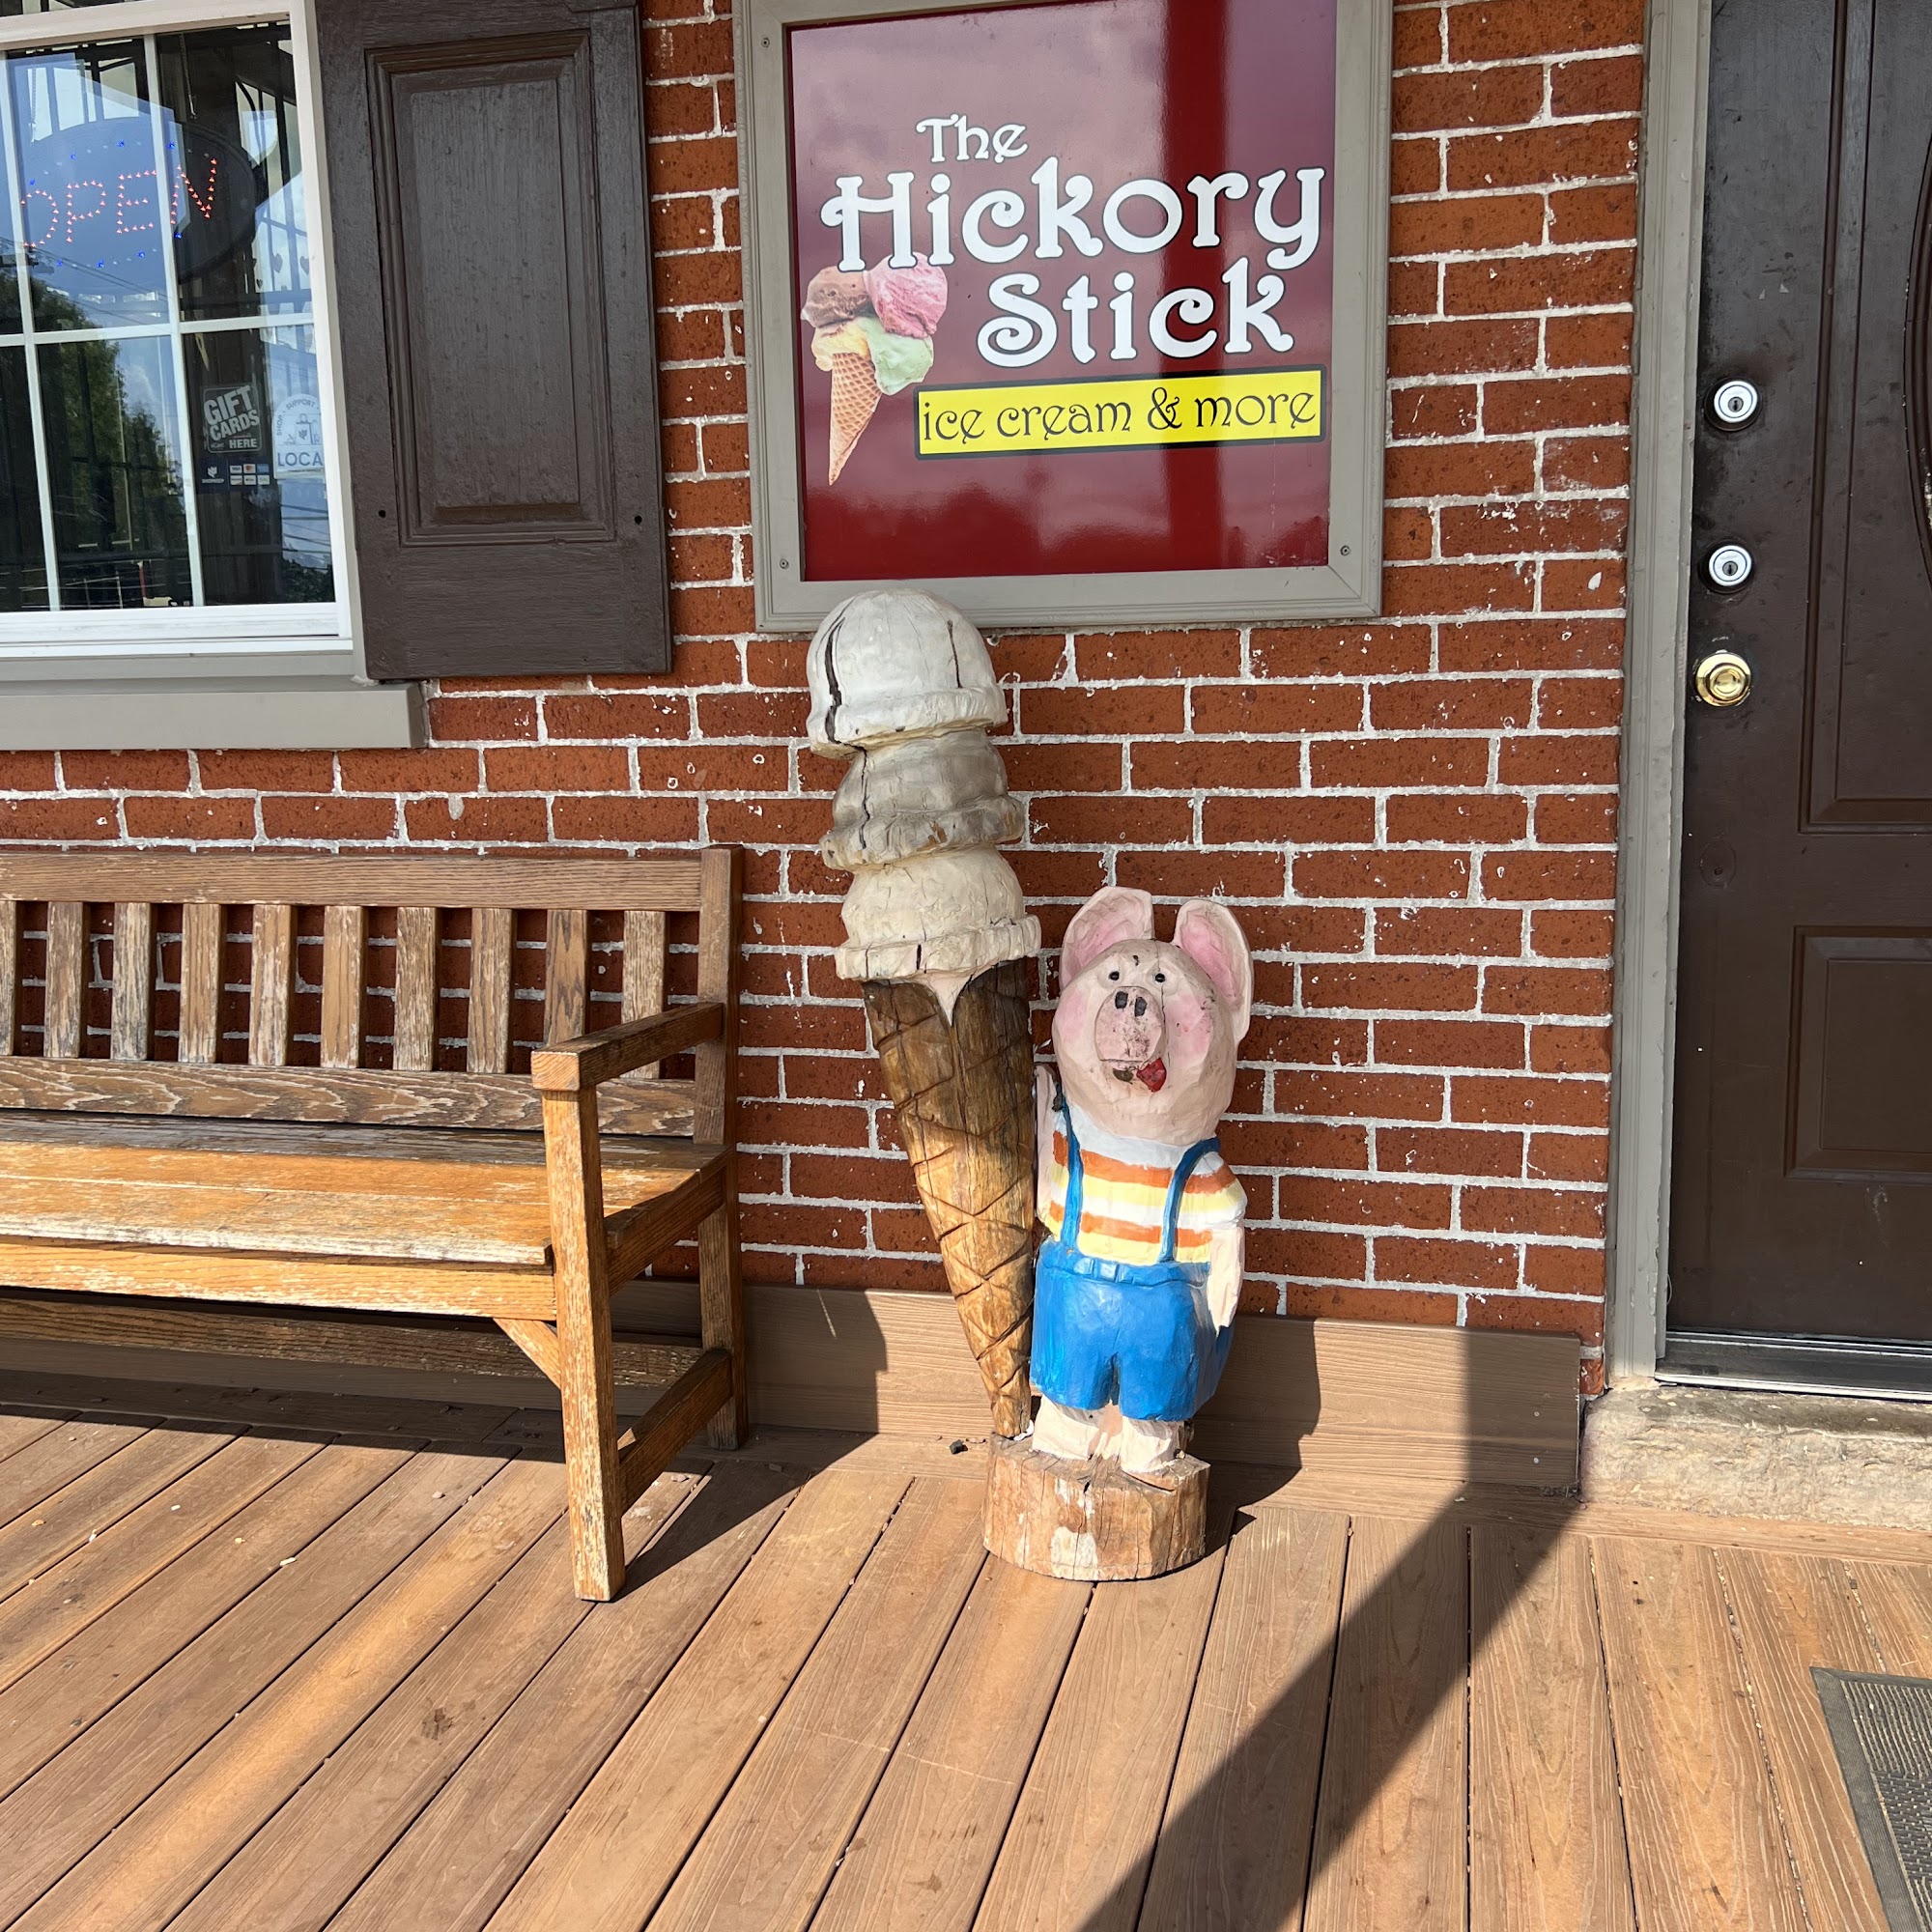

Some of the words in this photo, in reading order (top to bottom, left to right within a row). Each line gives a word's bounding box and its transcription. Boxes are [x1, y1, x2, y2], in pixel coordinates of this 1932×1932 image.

[915, 113, 1029, 163] The
[20, 157, 217, 247] OPEN
[820, 156, 1326, 271] Hickory
[977, 257, 1294, 368] Stick
[204, 385, 251, 425] GIFT
[210, 410, 260, 440] CARDS
[286, 398, 316, 410] SUPPORT
[922, 401, 985, 441] ice
[996, 394, 1132, 438] cream
[1147, 386, 1183, 431] &
[1194, 388, 1318, 432] more
[228, 439, 257, 449] HERE
[277, 452, 323, 467] LOCA
